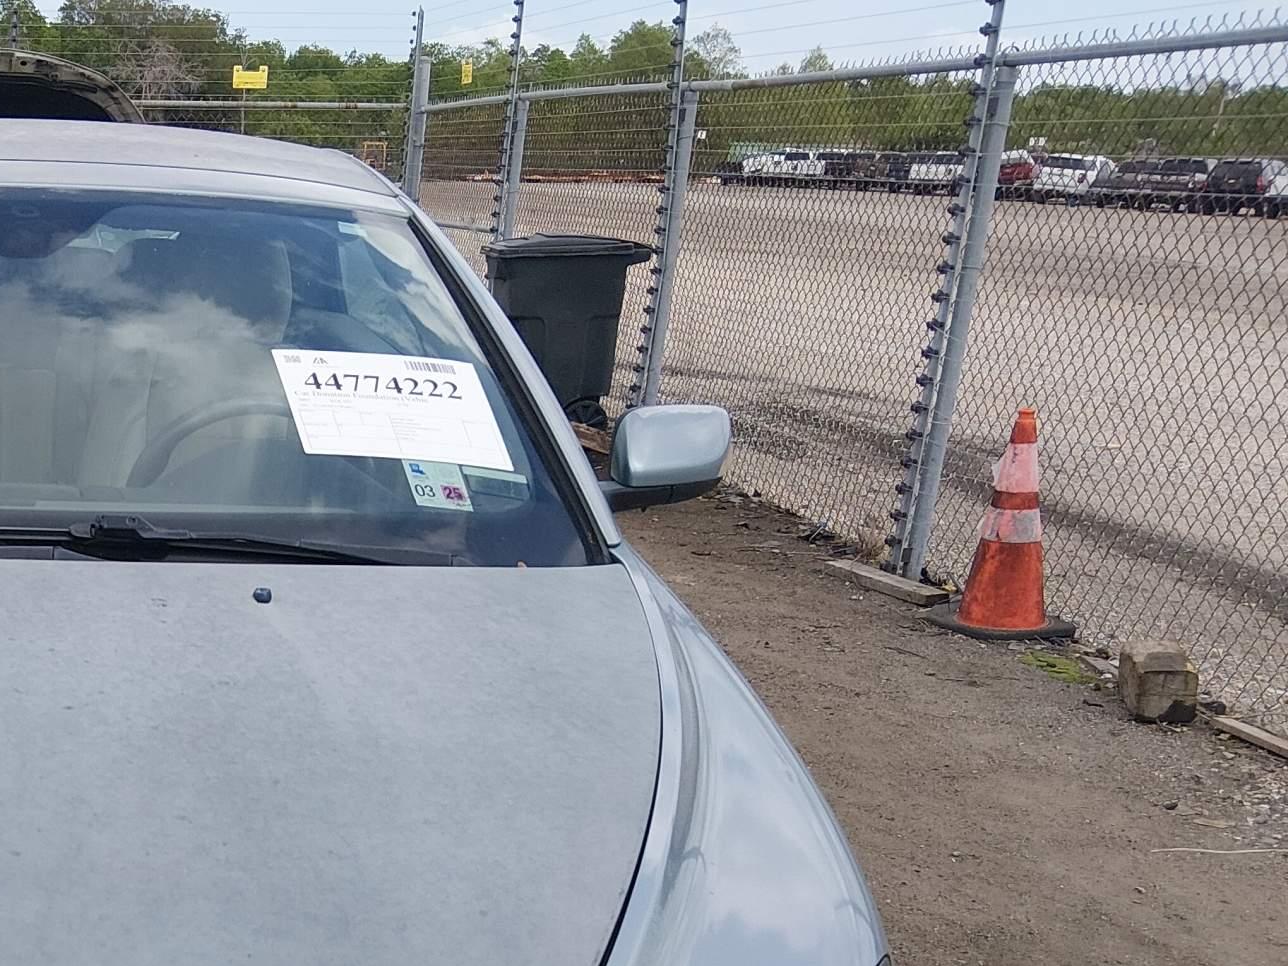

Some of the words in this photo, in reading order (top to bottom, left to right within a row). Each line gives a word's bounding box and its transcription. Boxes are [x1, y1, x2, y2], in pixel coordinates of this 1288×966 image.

[304, 372, 463, 400] 44774222
[414, 483, 436, 498] 03
[443, 485, 464, 501] 25
